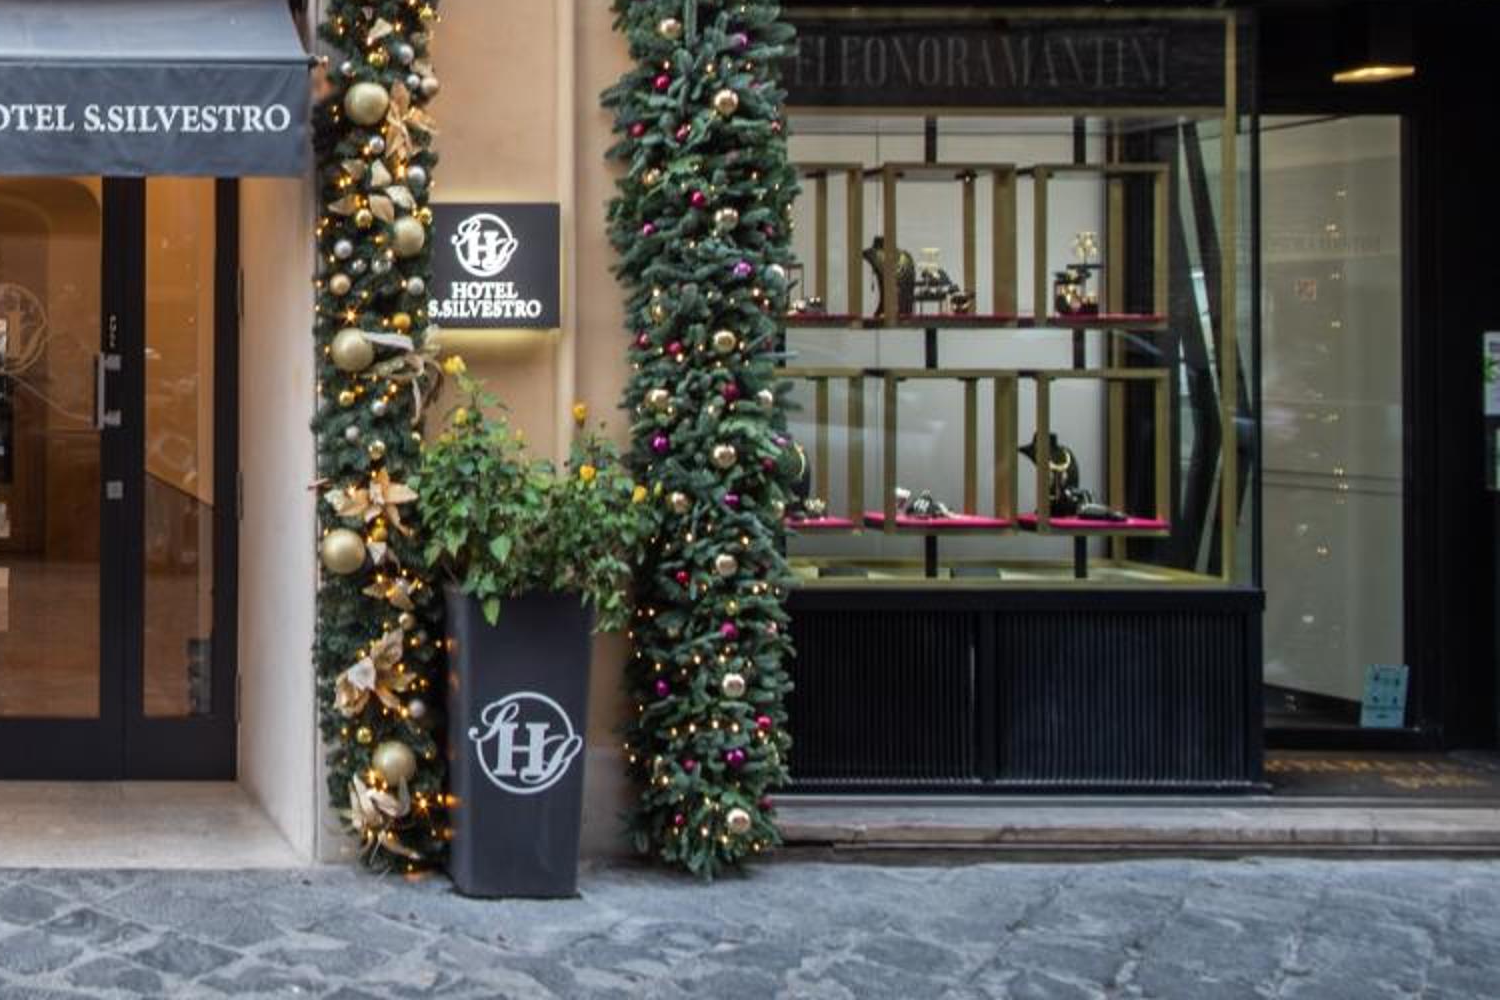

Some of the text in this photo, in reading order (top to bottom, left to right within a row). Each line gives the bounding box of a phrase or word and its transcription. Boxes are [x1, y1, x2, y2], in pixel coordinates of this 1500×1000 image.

[84, 103, 292, 133] S.SILVESTRO
[451, 280, 519, 300] HOTEL
[427, 299, 542, 318] S.SILVESTRO
